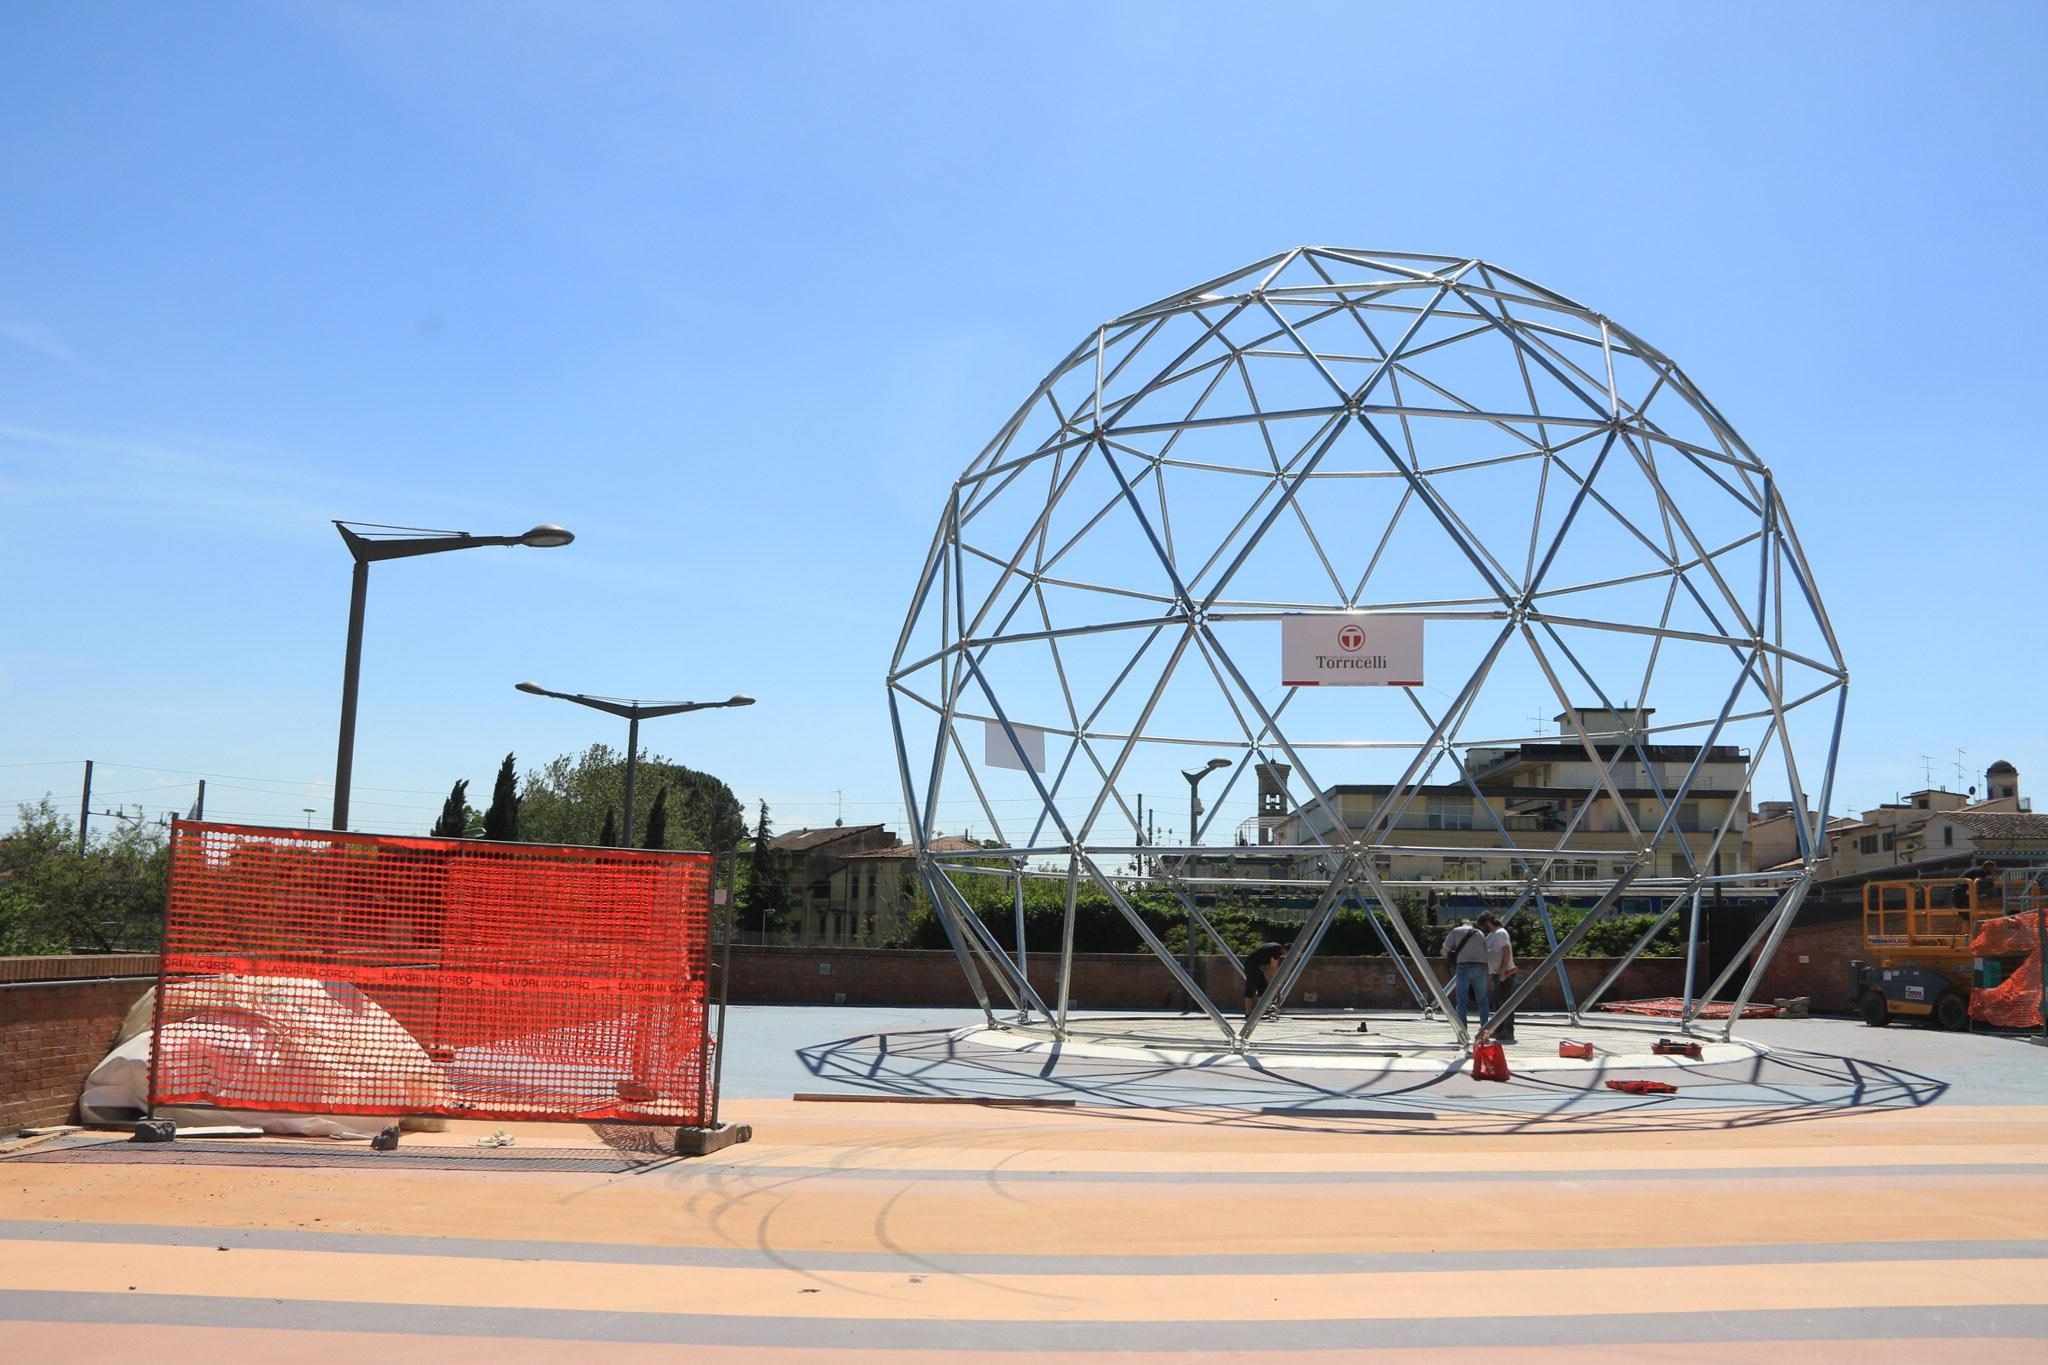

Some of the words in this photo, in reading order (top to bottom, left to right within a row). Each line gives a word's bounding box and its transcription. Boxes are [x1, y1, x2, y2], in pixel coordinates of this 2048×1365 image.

[1315, 655, 1387, 669] Torricelli
[198, 960, 236, 970] CORSO
[265, 965, 304, 975] LAVORI
[306, 967, 316, 976] IN
[319, 968, 355, 978] CORSO
[385, 972, 423, 981] LAVORI
[424, 974, 435, 983] IN
[438, 975, 474, 985] CORSO
[502, 978, 539, 988] LAVORI
[540, 979, 551, 988] IN
[553, 980, 590, 990] CORSO
[618, 983, 655, 992] LAVORI
[656, 984, 666, 992] IN
[669, 984, 705, 993] CORSO
